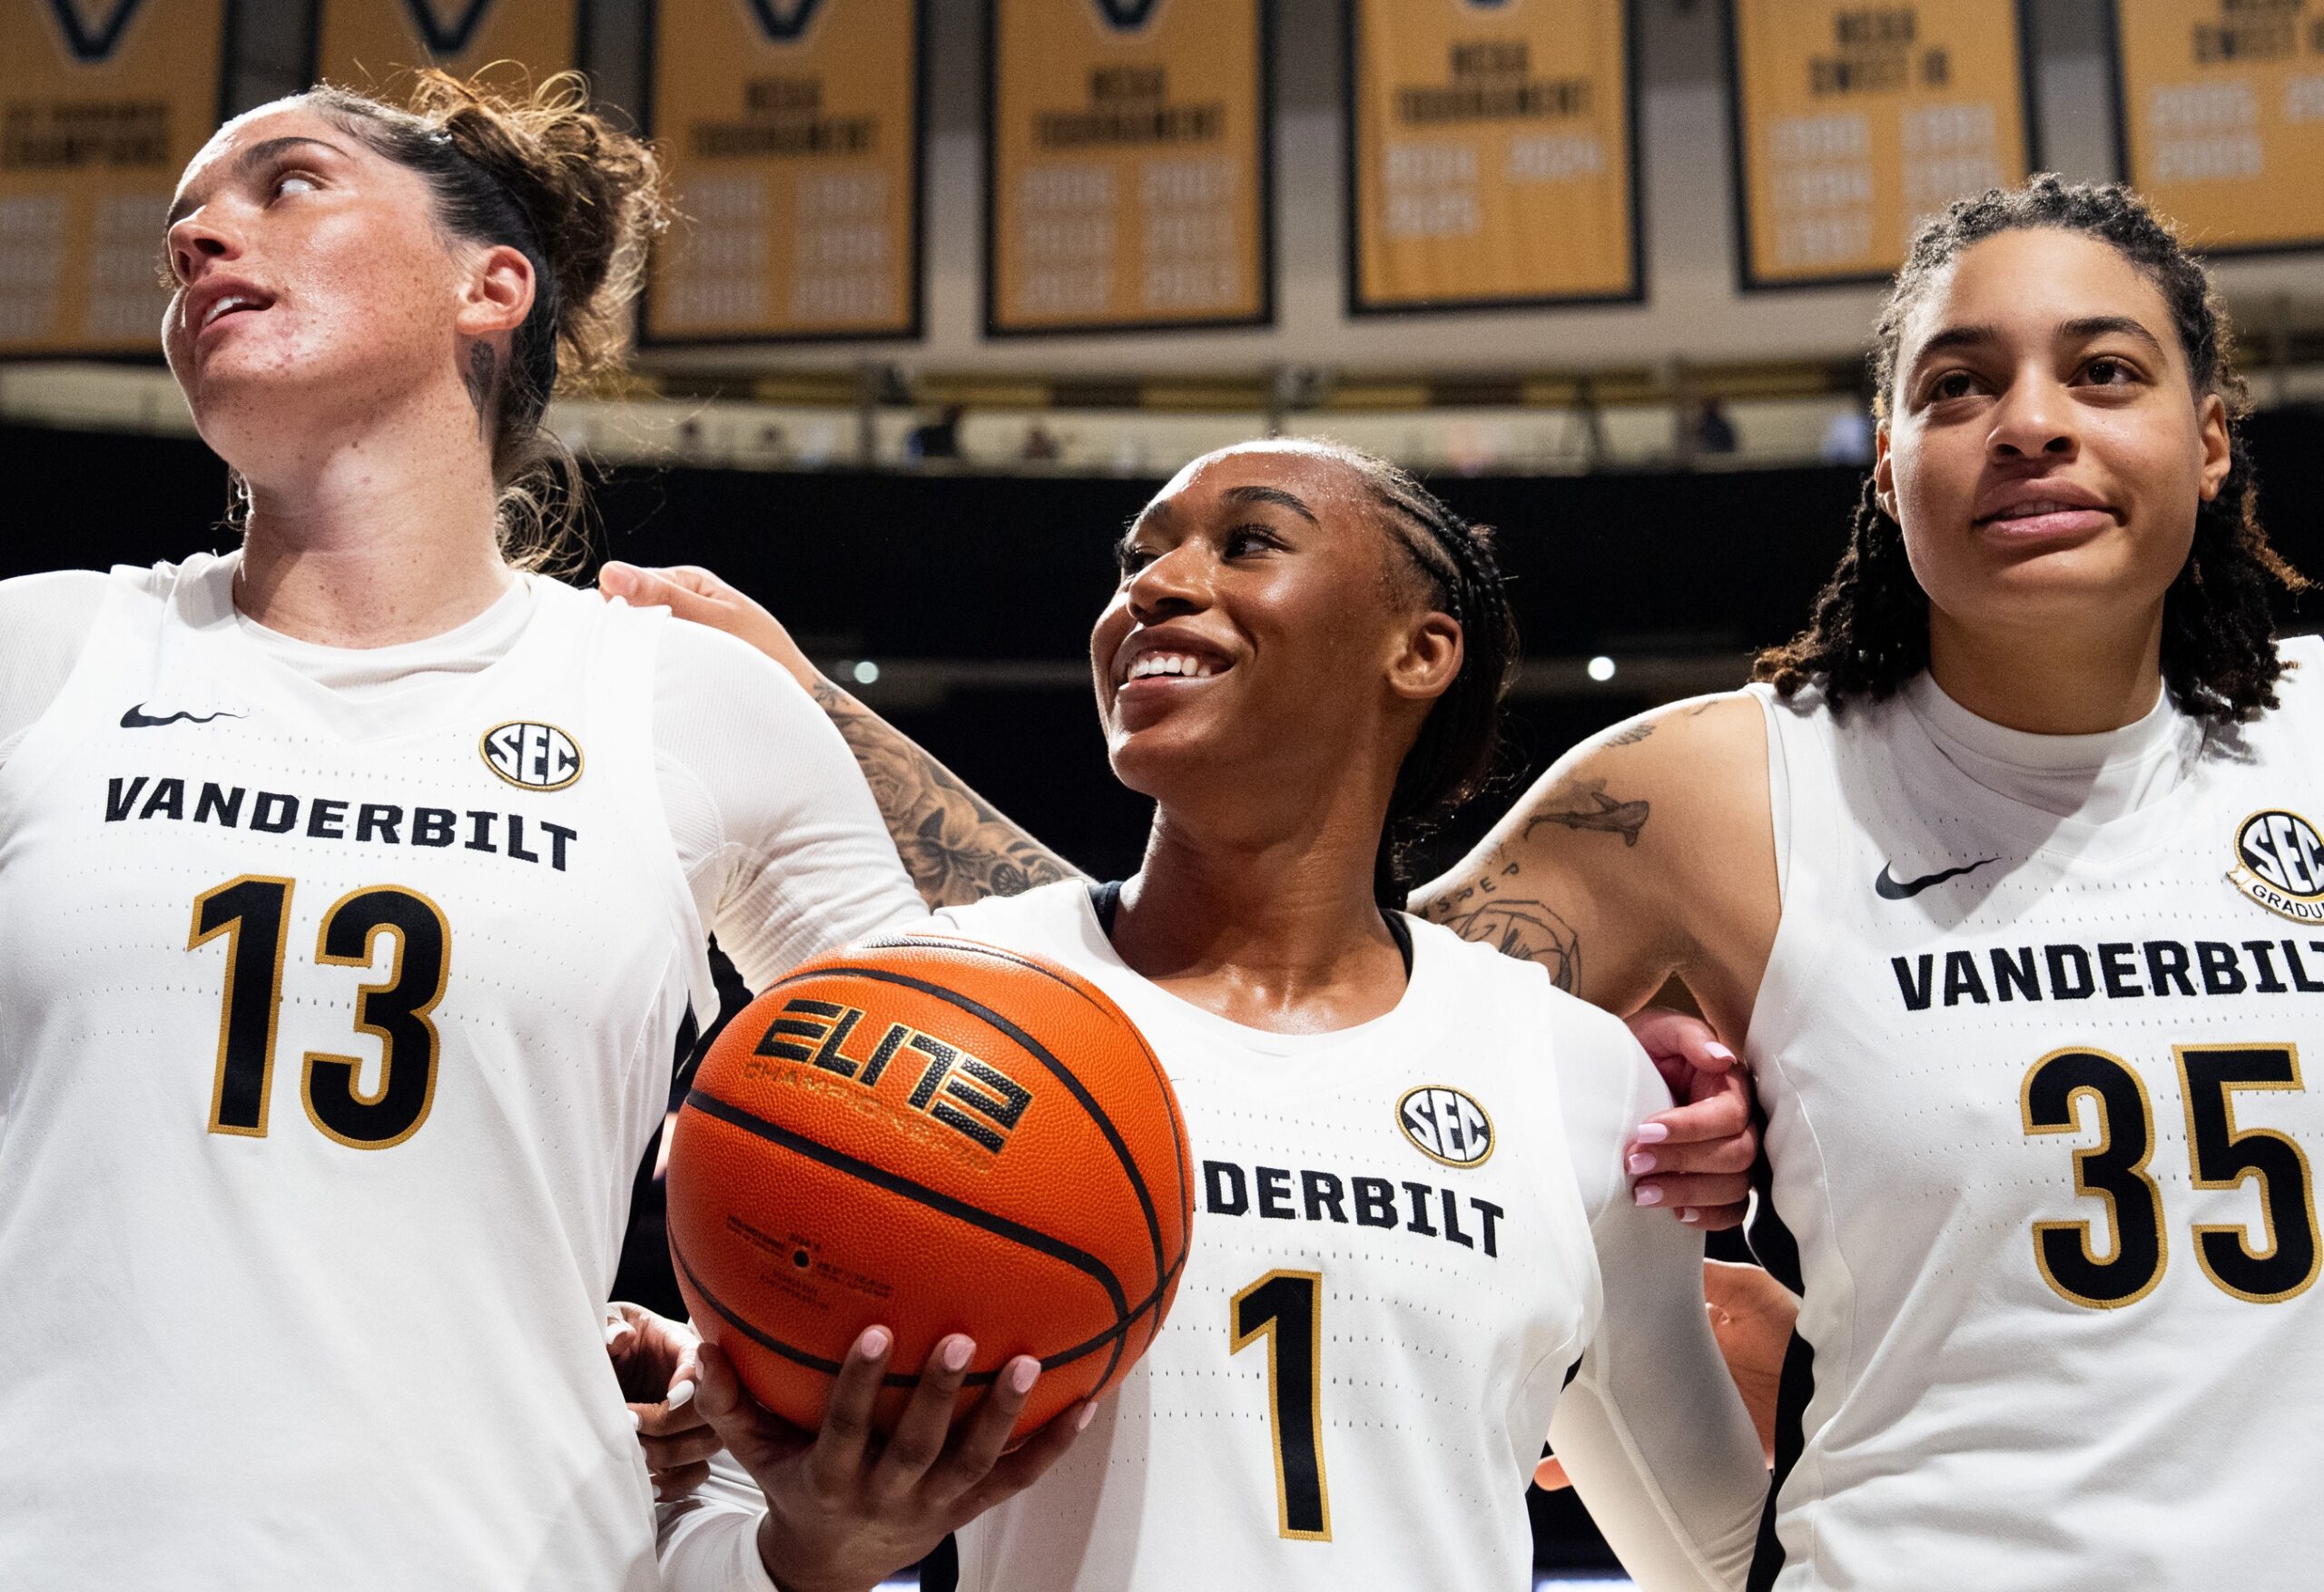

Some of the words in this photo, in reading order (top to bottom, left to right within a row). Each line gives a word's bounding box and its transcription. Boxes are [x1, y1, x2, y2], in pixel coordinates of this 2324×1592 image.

[487, 722, 576, 787] SEC
[104, 775, 577, 871] VANDERBILT
[2241, 814, 2324, 893] SEC
[2252, 884, 2324, 919] GRADU
[187, 873, 452, 1151] 13
[753, 997, 1033, 1155] ELITE
[1403, 1088, 1488, 1163] SEC
[1202, 1159, 1504, 1258] DERBILT
[2019, 1042, 2323, 1310] 35
[1230, 1268, 1332, 1542] 1
